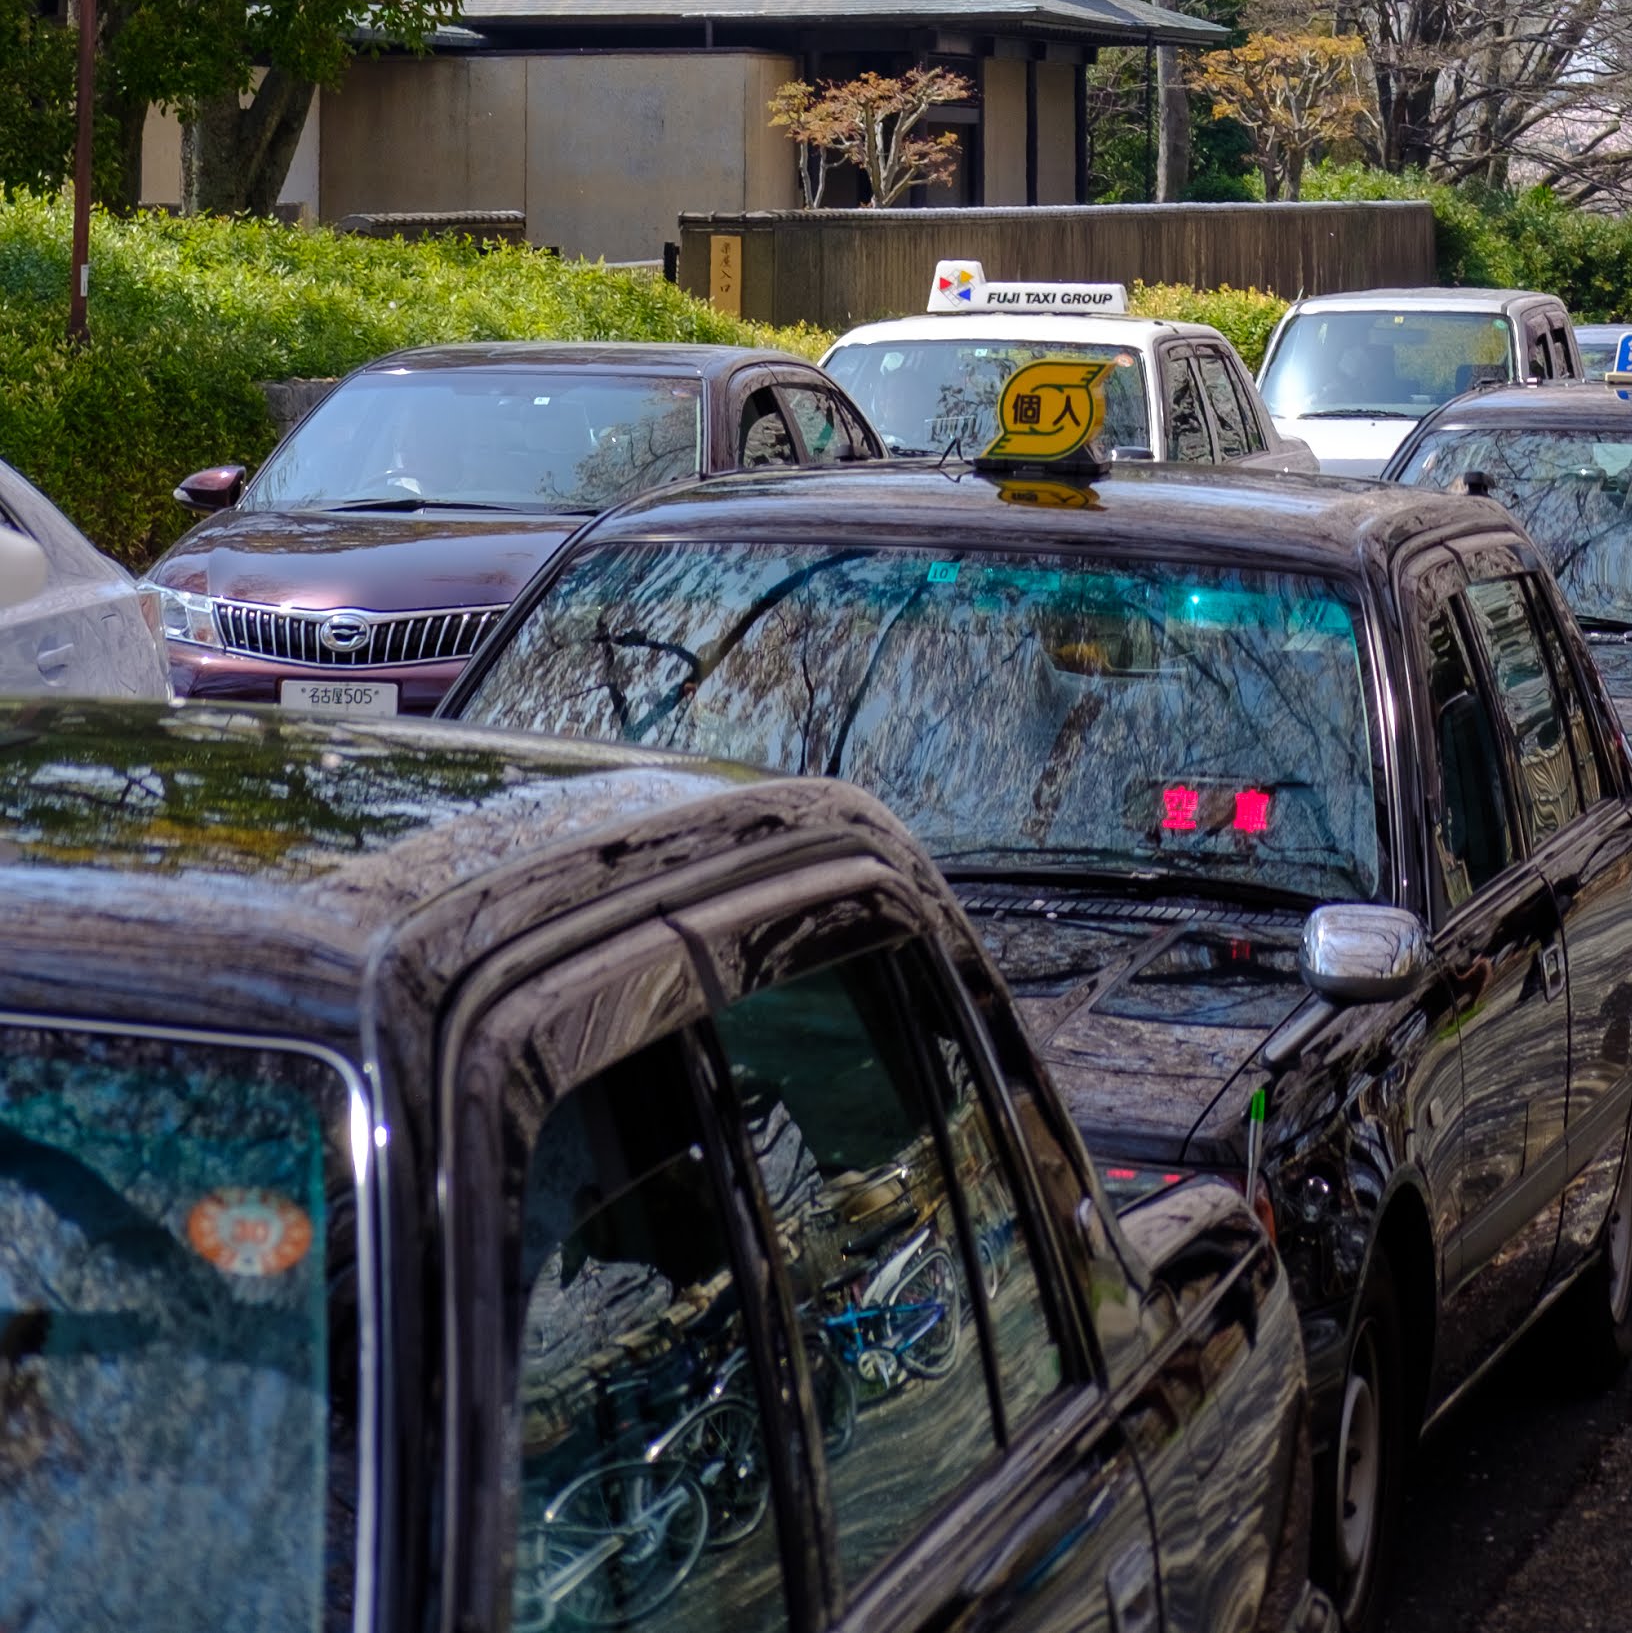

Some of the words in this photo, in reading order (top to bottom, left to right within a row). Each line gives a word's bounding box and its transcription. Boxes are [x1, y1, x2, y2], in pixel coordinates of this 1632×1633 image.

[986, 292, 1020, 304] FUJI
[1025, 292, 1057, 305] TAXI
[1061, 292, 1113, 305] GROUP
[1011, 393, 1081, 428] 個人
